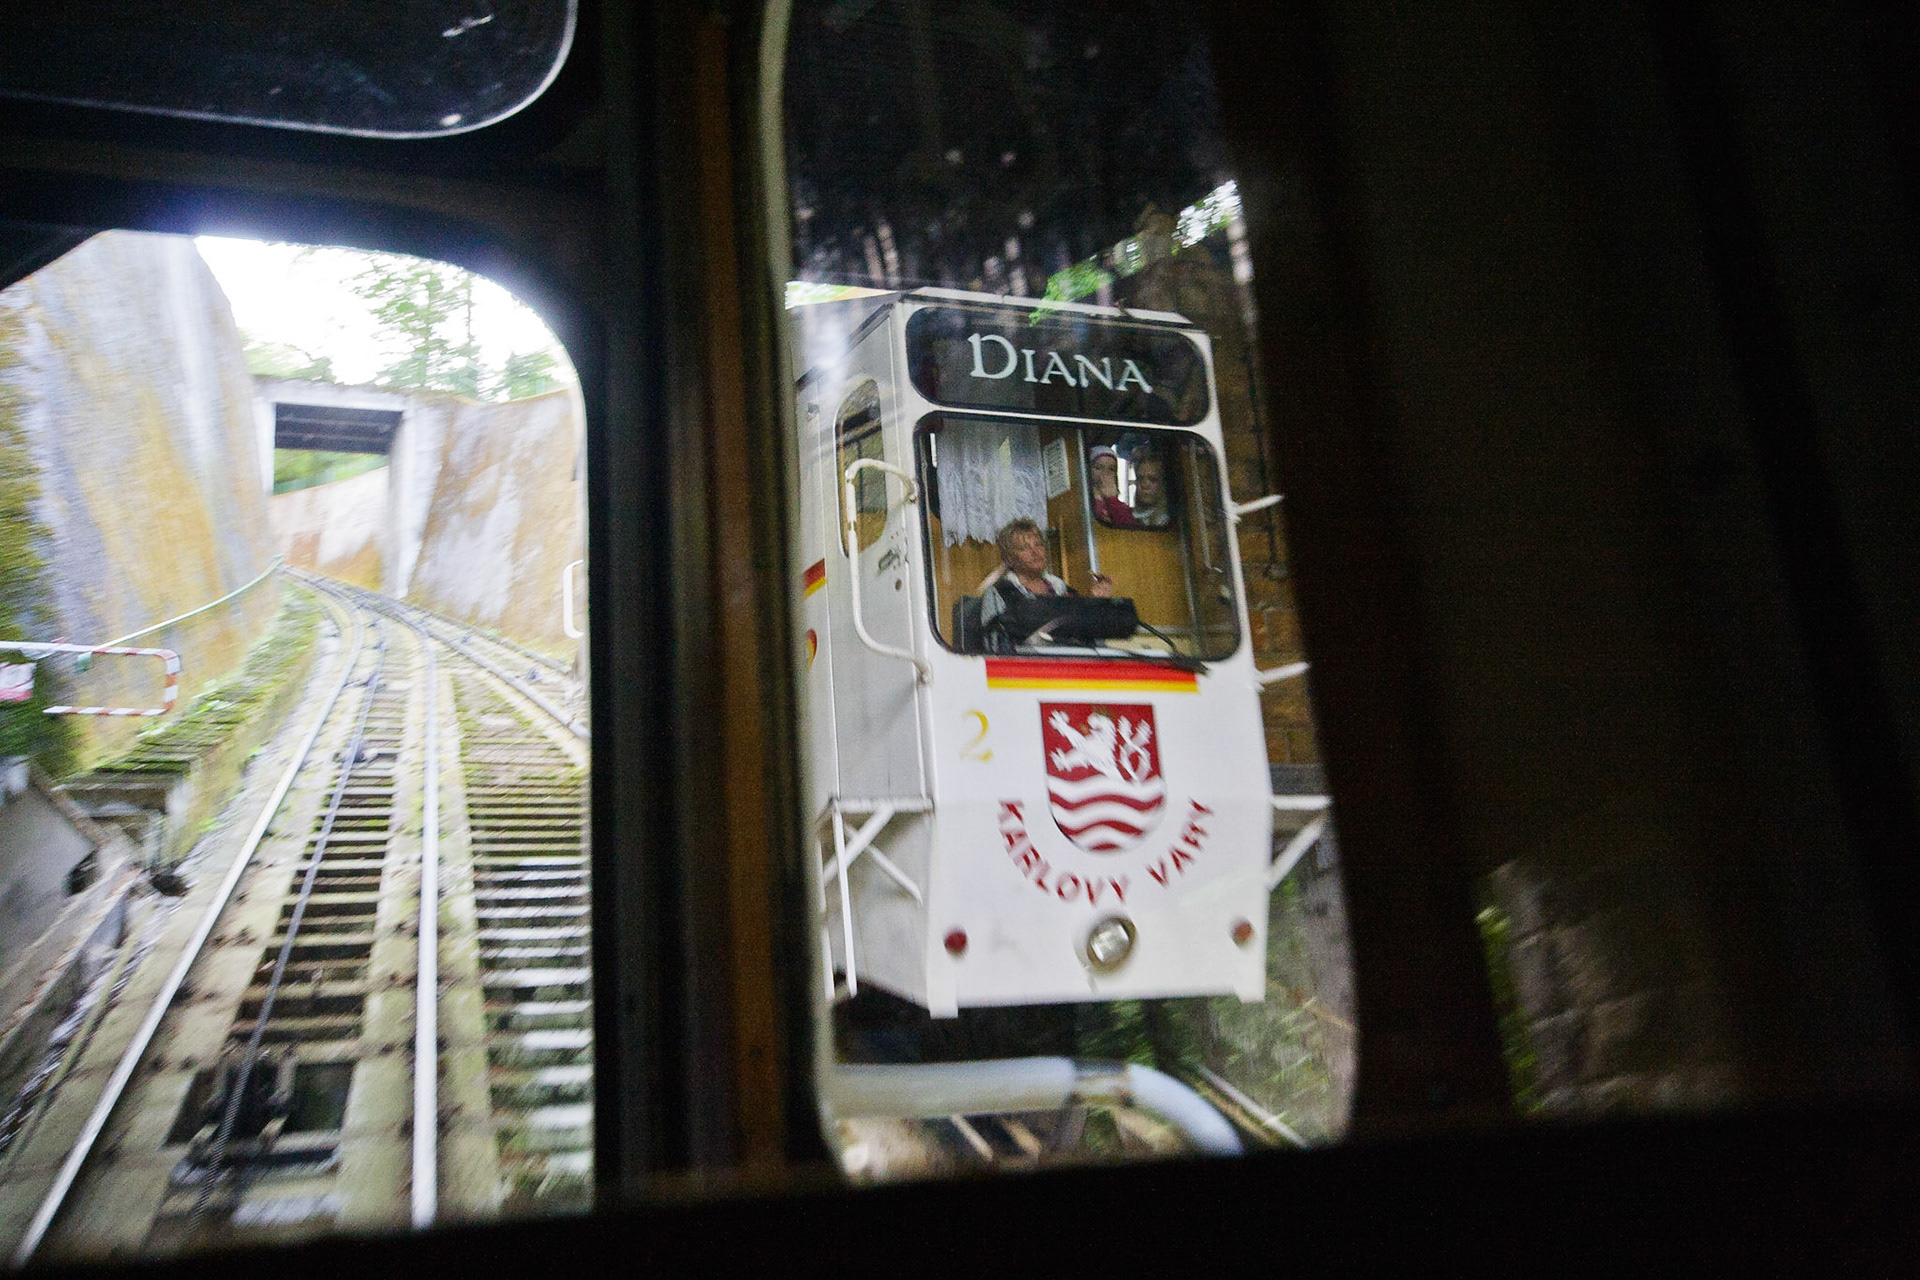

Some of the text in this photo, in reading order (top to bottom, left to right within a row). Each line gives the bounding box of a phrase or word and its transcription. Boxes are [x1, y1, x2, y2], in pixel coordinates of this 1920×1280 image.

[959, 707, 994, 763] 2
[997, 796, 1214, 906] KARLOVY VARY
